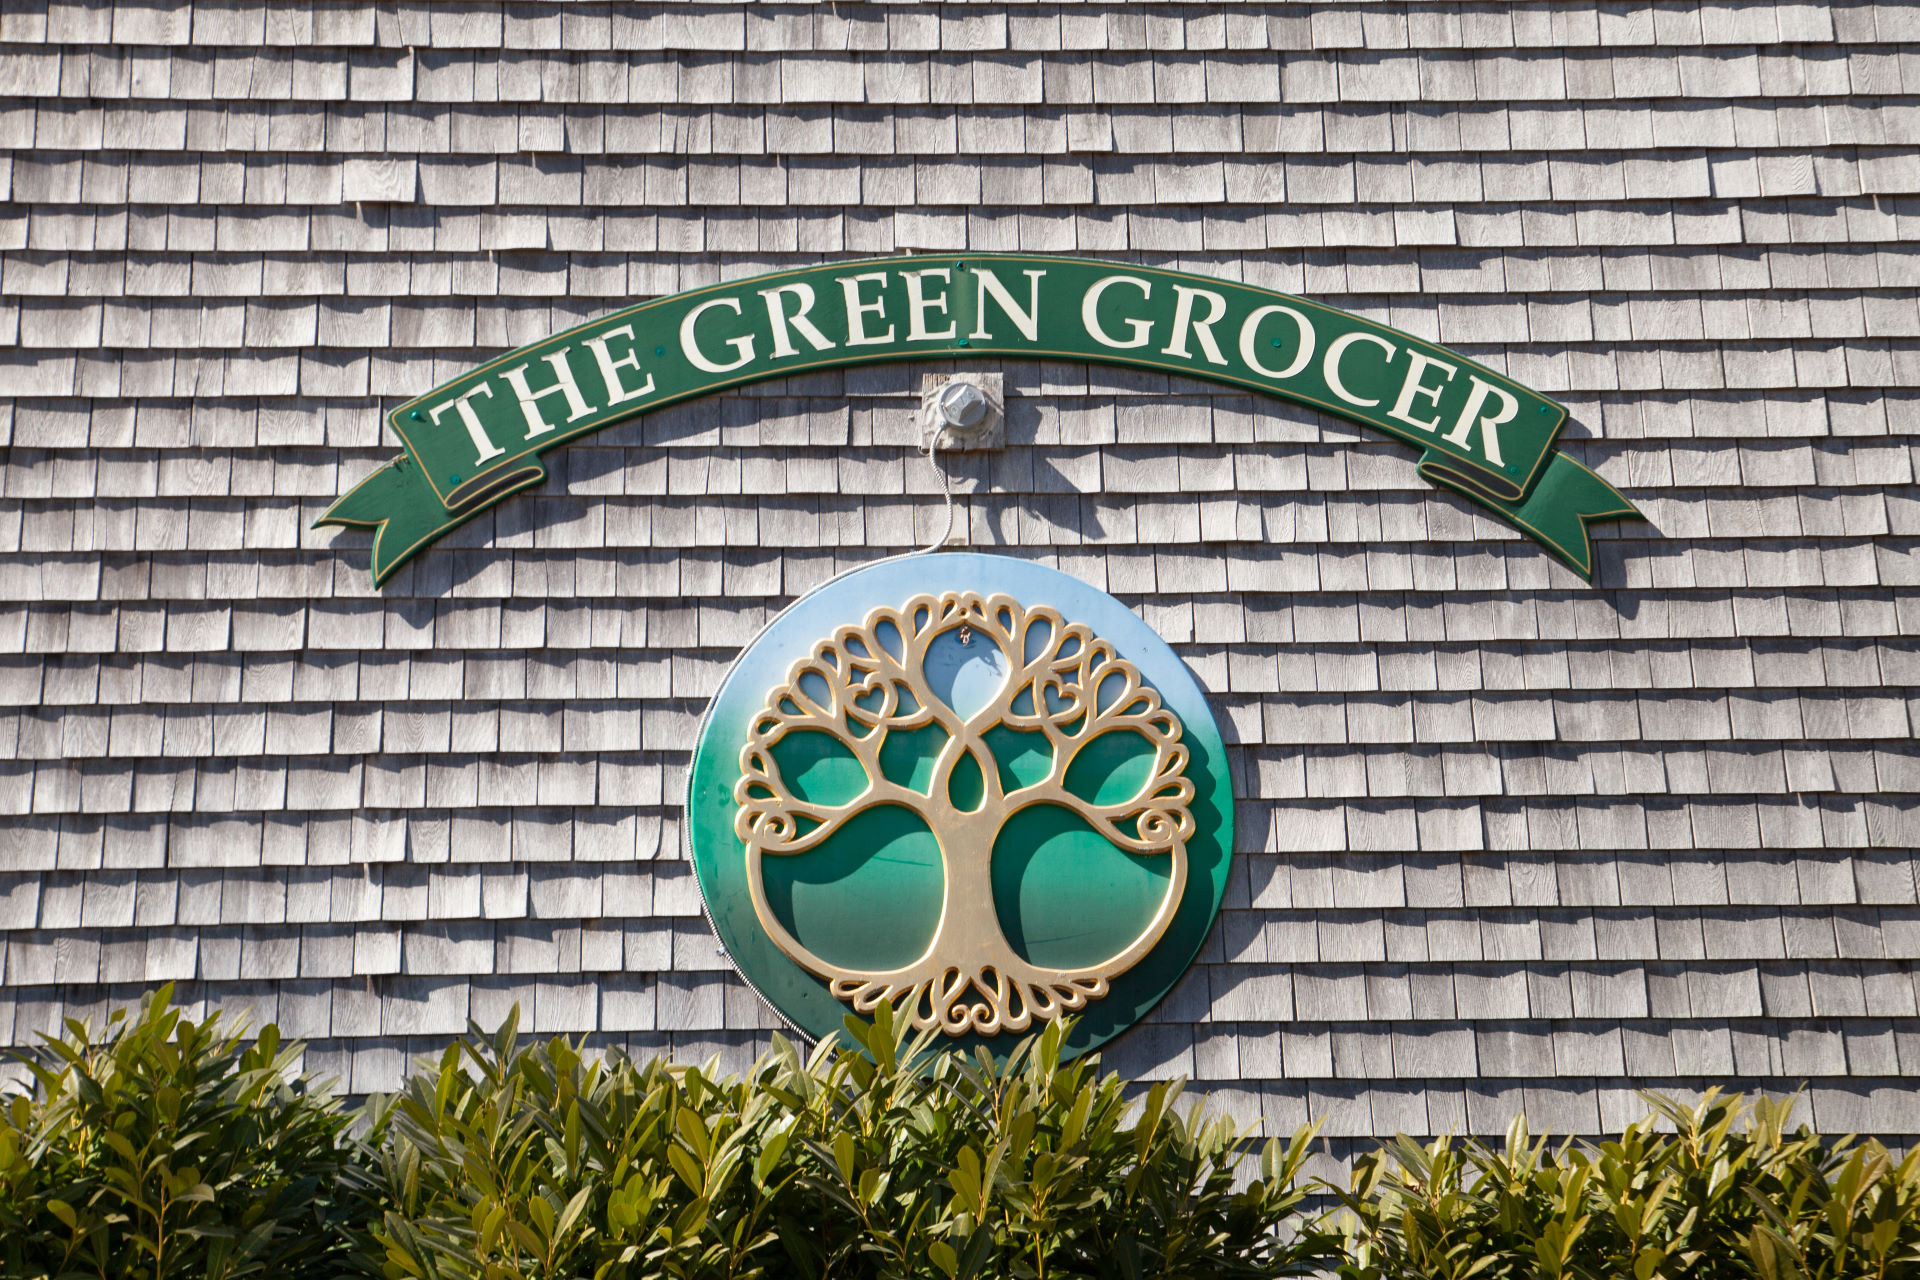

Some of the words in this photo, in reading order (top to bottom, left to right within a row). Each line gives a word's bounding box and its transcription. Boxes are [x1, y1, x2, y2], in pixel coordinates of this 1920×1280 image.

[429, 323, 656, 467] THE
[680, 268, 1046, 373] GREEN
[1082, 275, 1520, 468] GROCER
